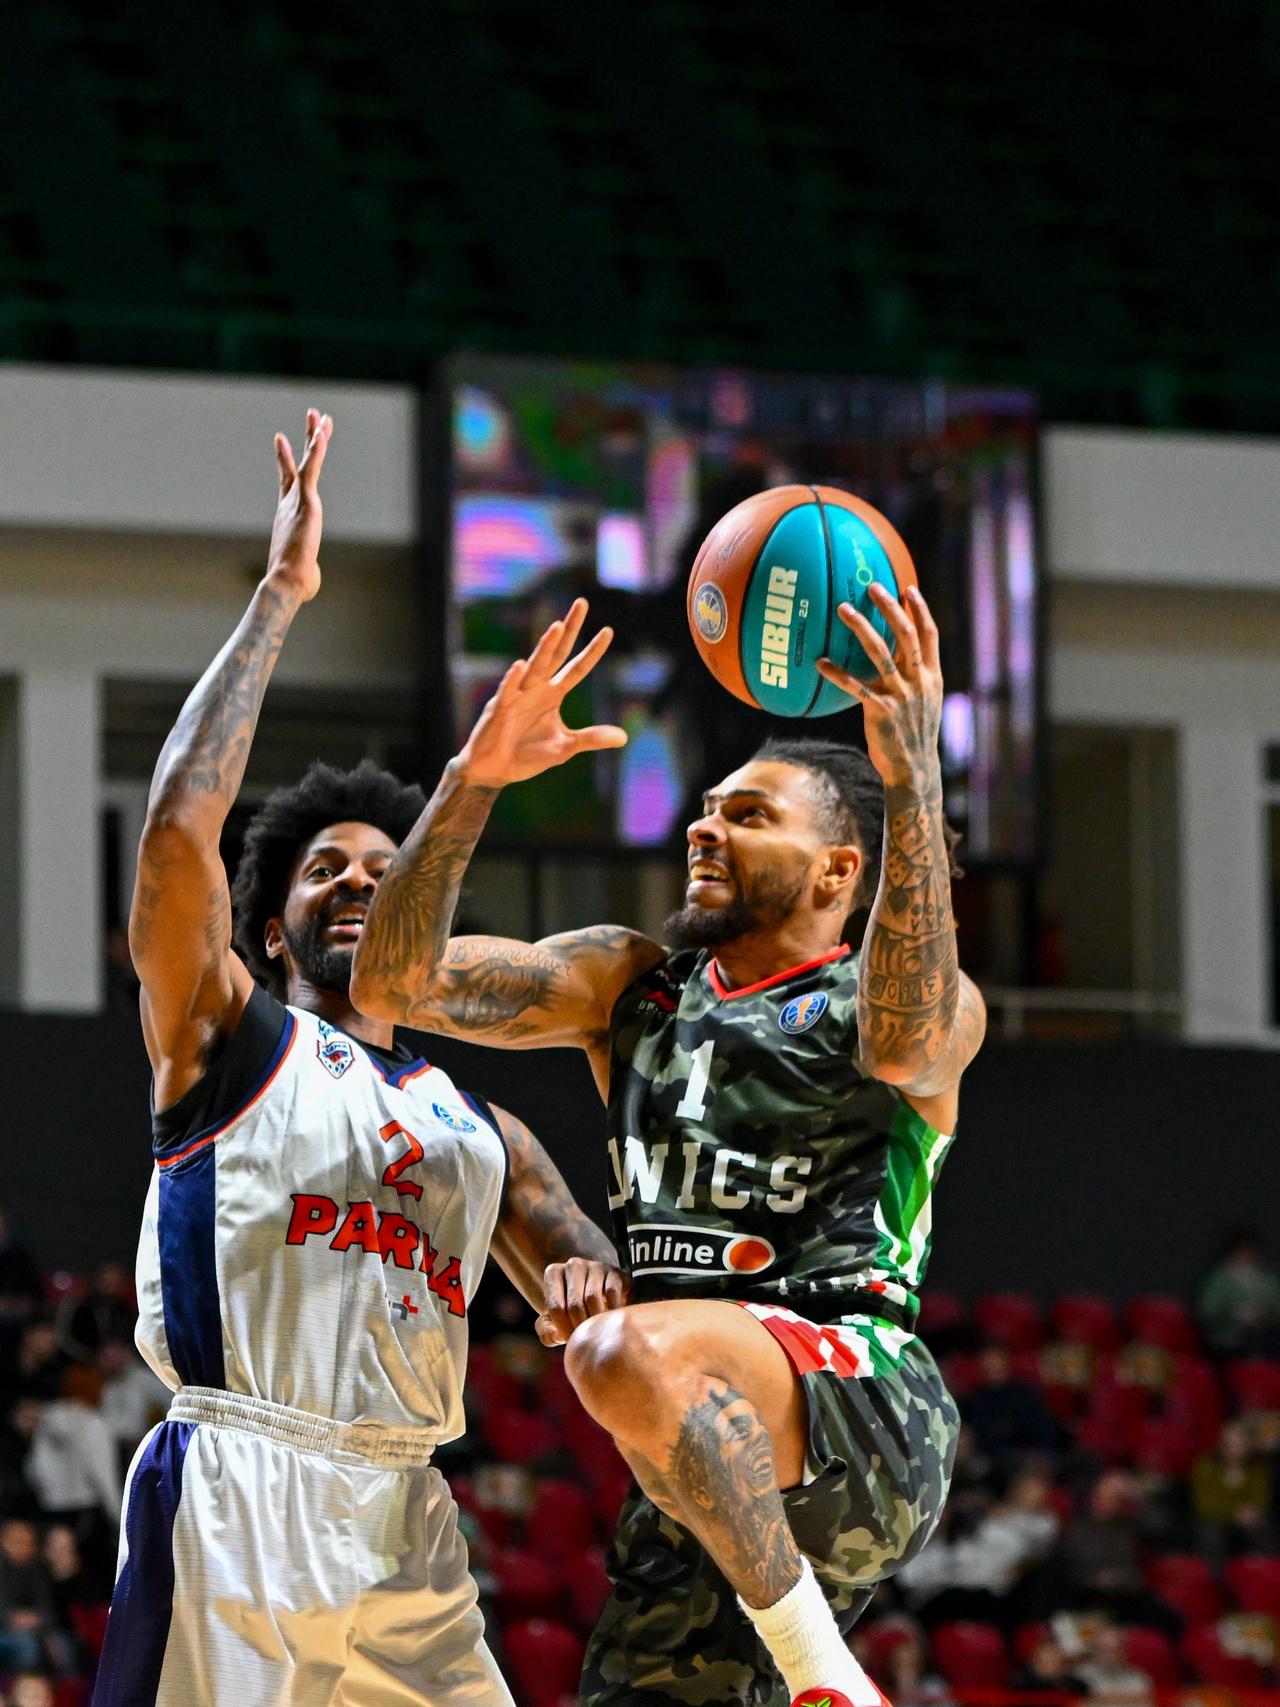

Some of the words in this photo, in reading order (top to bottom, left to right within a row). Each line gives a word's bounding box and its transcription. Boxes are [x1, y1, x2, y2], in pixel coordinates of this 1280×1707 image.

[760, 565, 799, 689] SIBUR
[675, 1040, 716, 1122] 1
[379, 1119, 425, 1201] 2
[629, 1235, 715, 1265] inline
